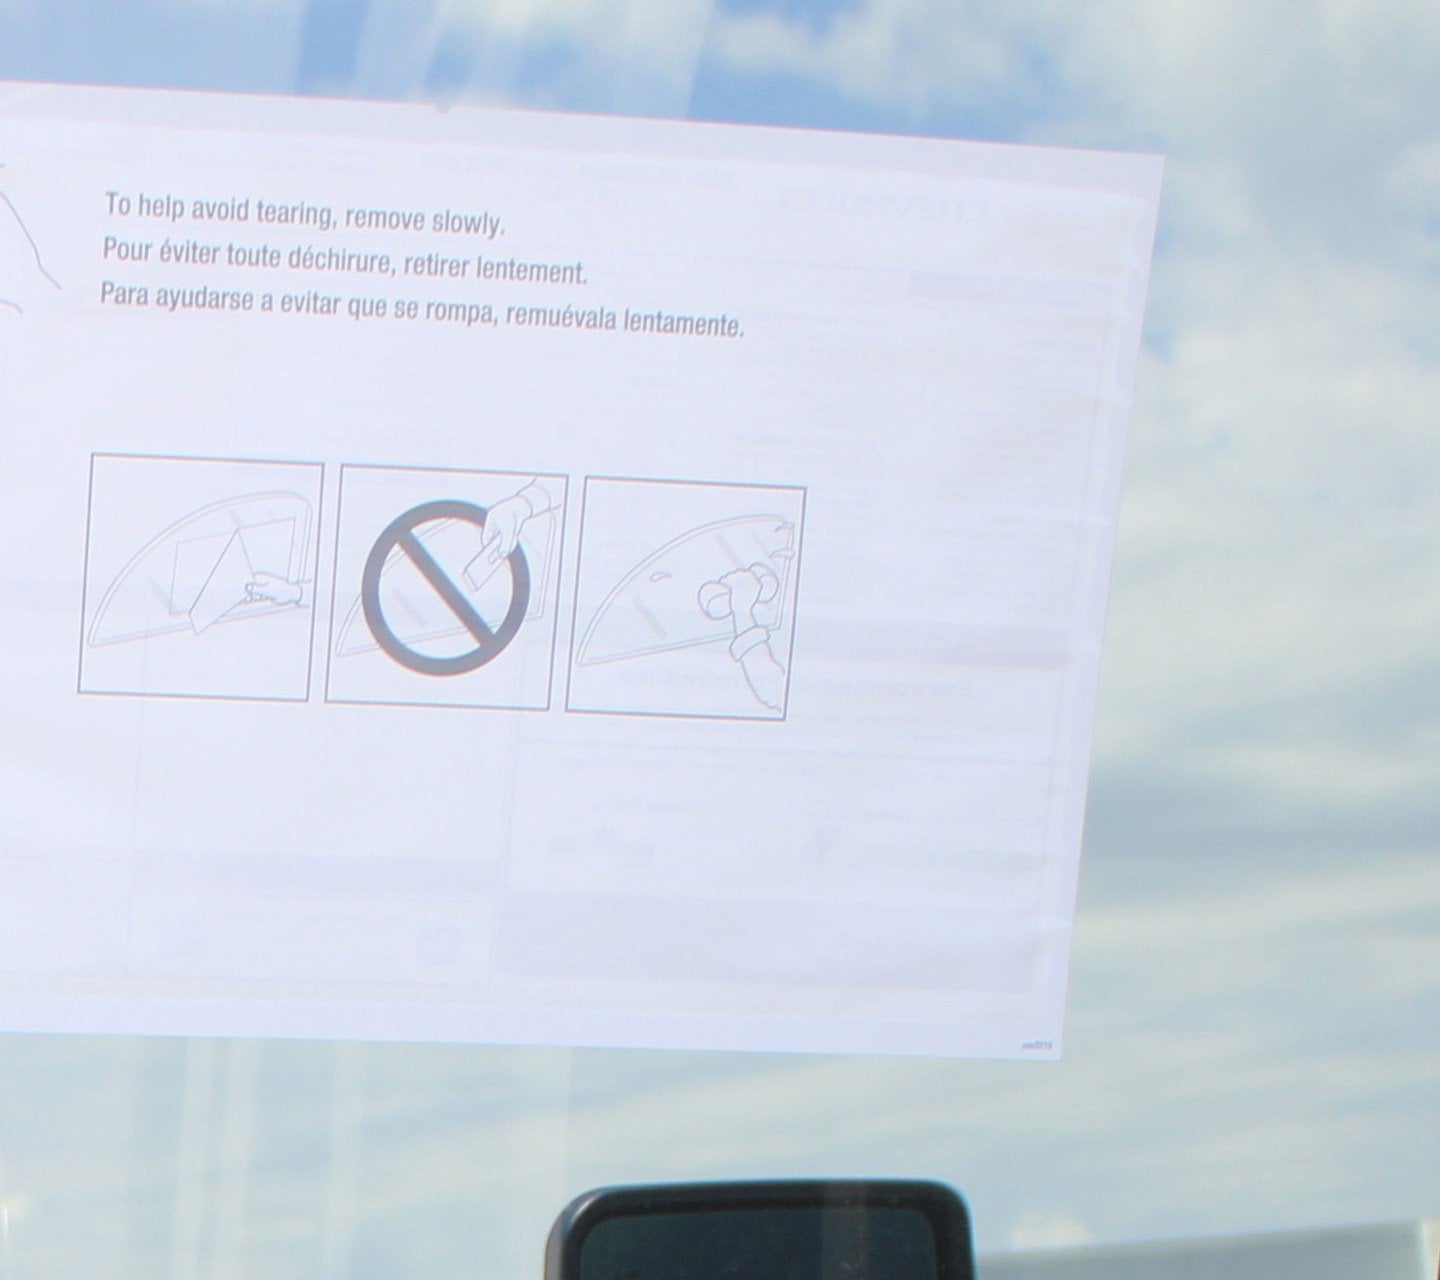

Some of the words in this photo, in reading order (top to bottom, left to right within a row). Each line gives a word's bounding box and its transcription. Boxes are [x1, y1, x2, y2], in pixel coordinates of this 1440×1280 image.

[105, 190, 131, 218] To
[137, 192, 185, 223] help
[191, 195, 250, 222] avoid
[256, 201, 338, 232] tearing,
[345, 206, 425, 232] remove
[431, 209, 506, 240] slowly.
[103, 235, 153, 262] Pour
[159, 238, 220, 265] éviter
[226, 242, 281, 268] toute
[288, 245, 397, 277] déchirure,
[404, 252, 471, 279] retirer
[476, 254, 588, 285] lentement.
[100, 280, 149, 305] Para
[156, 285, 253, 312] ayudarse
[260, 292, 273, 312] a
[280, 290, 342, 315] evitar
[347, 296, 387, 320] que
[394, 299, 419, 319] se
[425, 299, 499, 327] rompa,
[506, 303, 617, 331] remuévala
[623, 308, 745, 338] lentamente.
